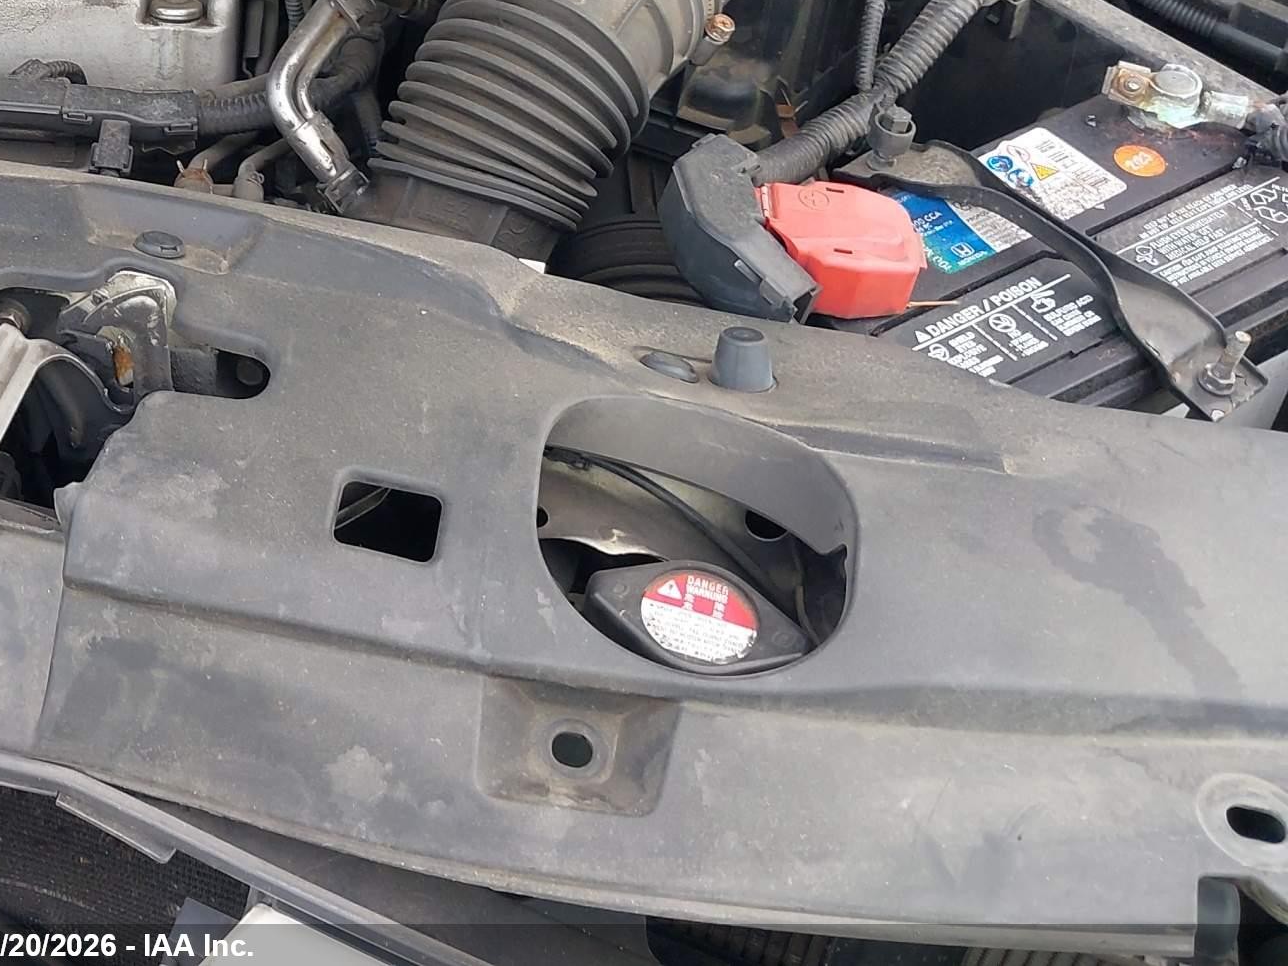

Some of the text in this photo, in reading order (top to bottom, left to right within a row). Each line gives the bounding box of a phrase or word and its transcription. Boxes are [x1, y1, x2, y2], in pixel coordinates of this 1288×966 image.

[923, 276, 1043, 336] DANGER / POISON
[687, 575, 729, 596] DANGER
